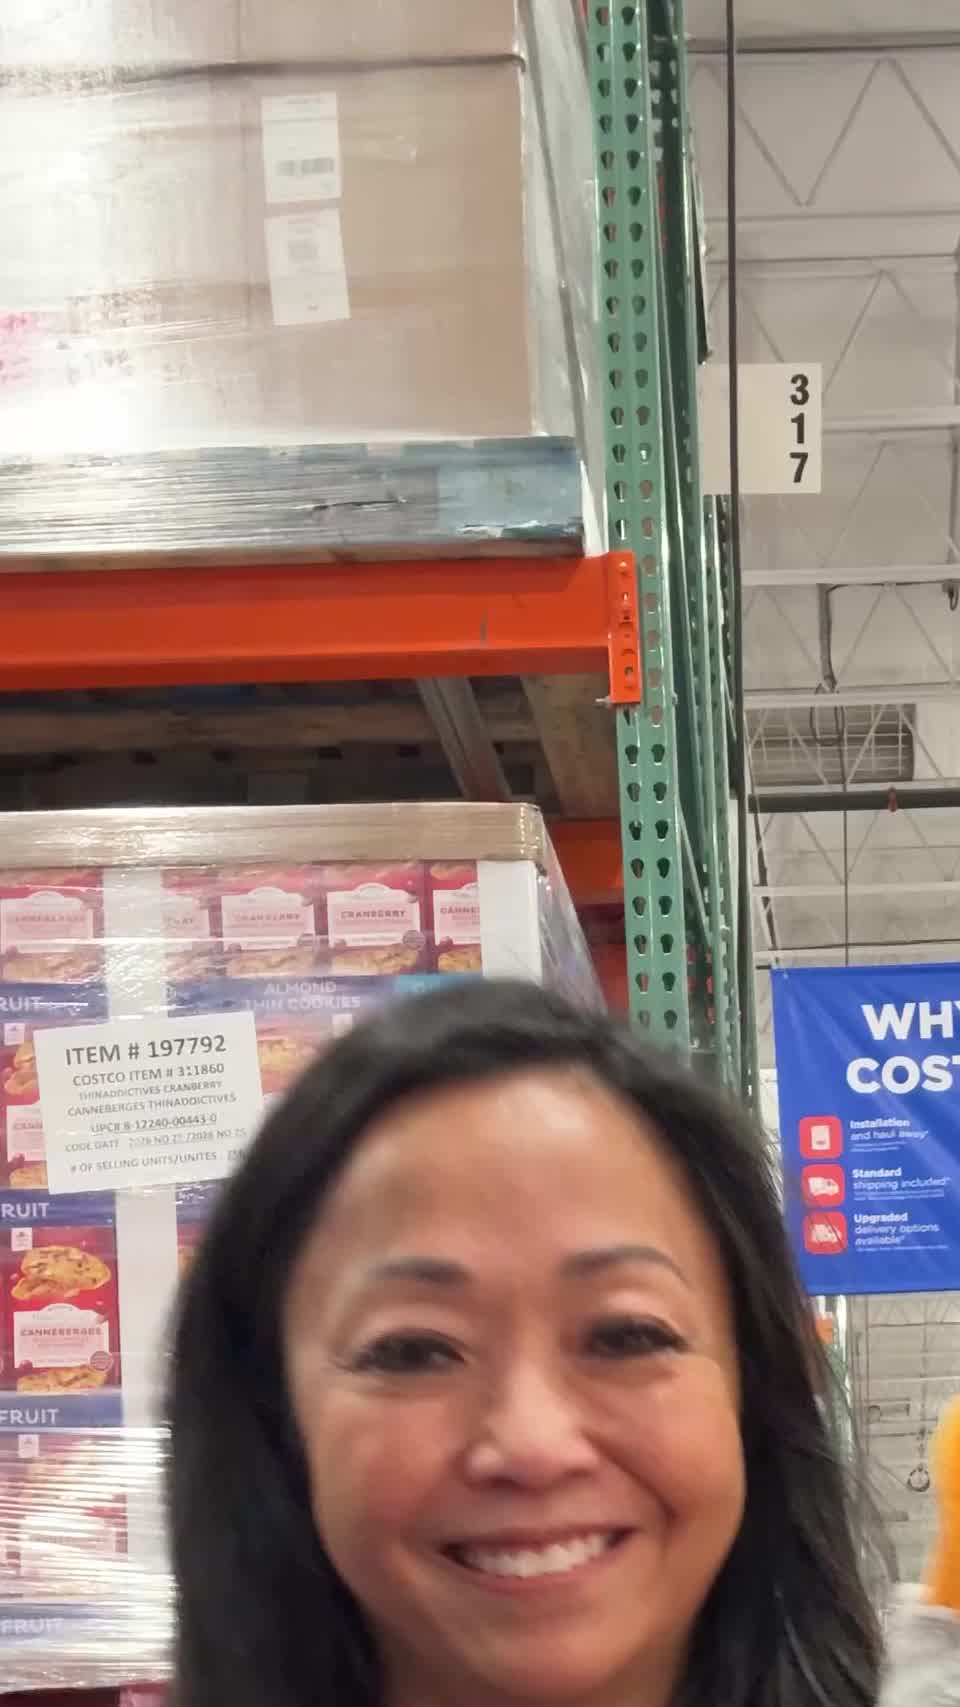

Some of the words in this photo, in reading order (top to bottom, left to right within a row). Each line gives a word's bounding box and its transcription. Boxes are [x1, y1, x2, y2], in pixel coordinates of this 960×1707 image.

[341, 909, 406, 921] CRANBERRY
[0, 996, 42, 1012] RUIT
[290, 995, 361, 1010] COOKIES
[65, 1044, 121, 1066] ITEM
[127, 1042, 140, 1060] #
[147, 1034, 227, 1059] 197792
[72, 1071, 125, 1087] COSTCO
[129, 1068, 162, 1081] ITEM
[165, 1067, 174, 1078] #
[79, 1085, 161, 1101] THINADDICTIVES
[163, 1080, 223, 1094] CRANBERRY
[67, 1102, 145, 1117] CANNEBERGES
[149, 1092, 237, 1109] THINADDICTIVES
[850, 1117, 910, 1130] Installation
[850, 1130, 871, 1141] and
[873, 1130, 896, 1140] haul
[80, 1161, 94, 1172] OF
[97, 1157, 139, 1171] SELLING
[142, 1151, 217, 1168] UNITS/UNITES
[852, 1167, 902, 1178] Standard
[853, 1179, 898, 1191] shipping
[2, 1203, 50, 1219] RUIT
[854, 1212, 908, 1225] Upgraded
[855, 1224, 897, 1236] delivery
[900, 1224, 940, 1235] options
